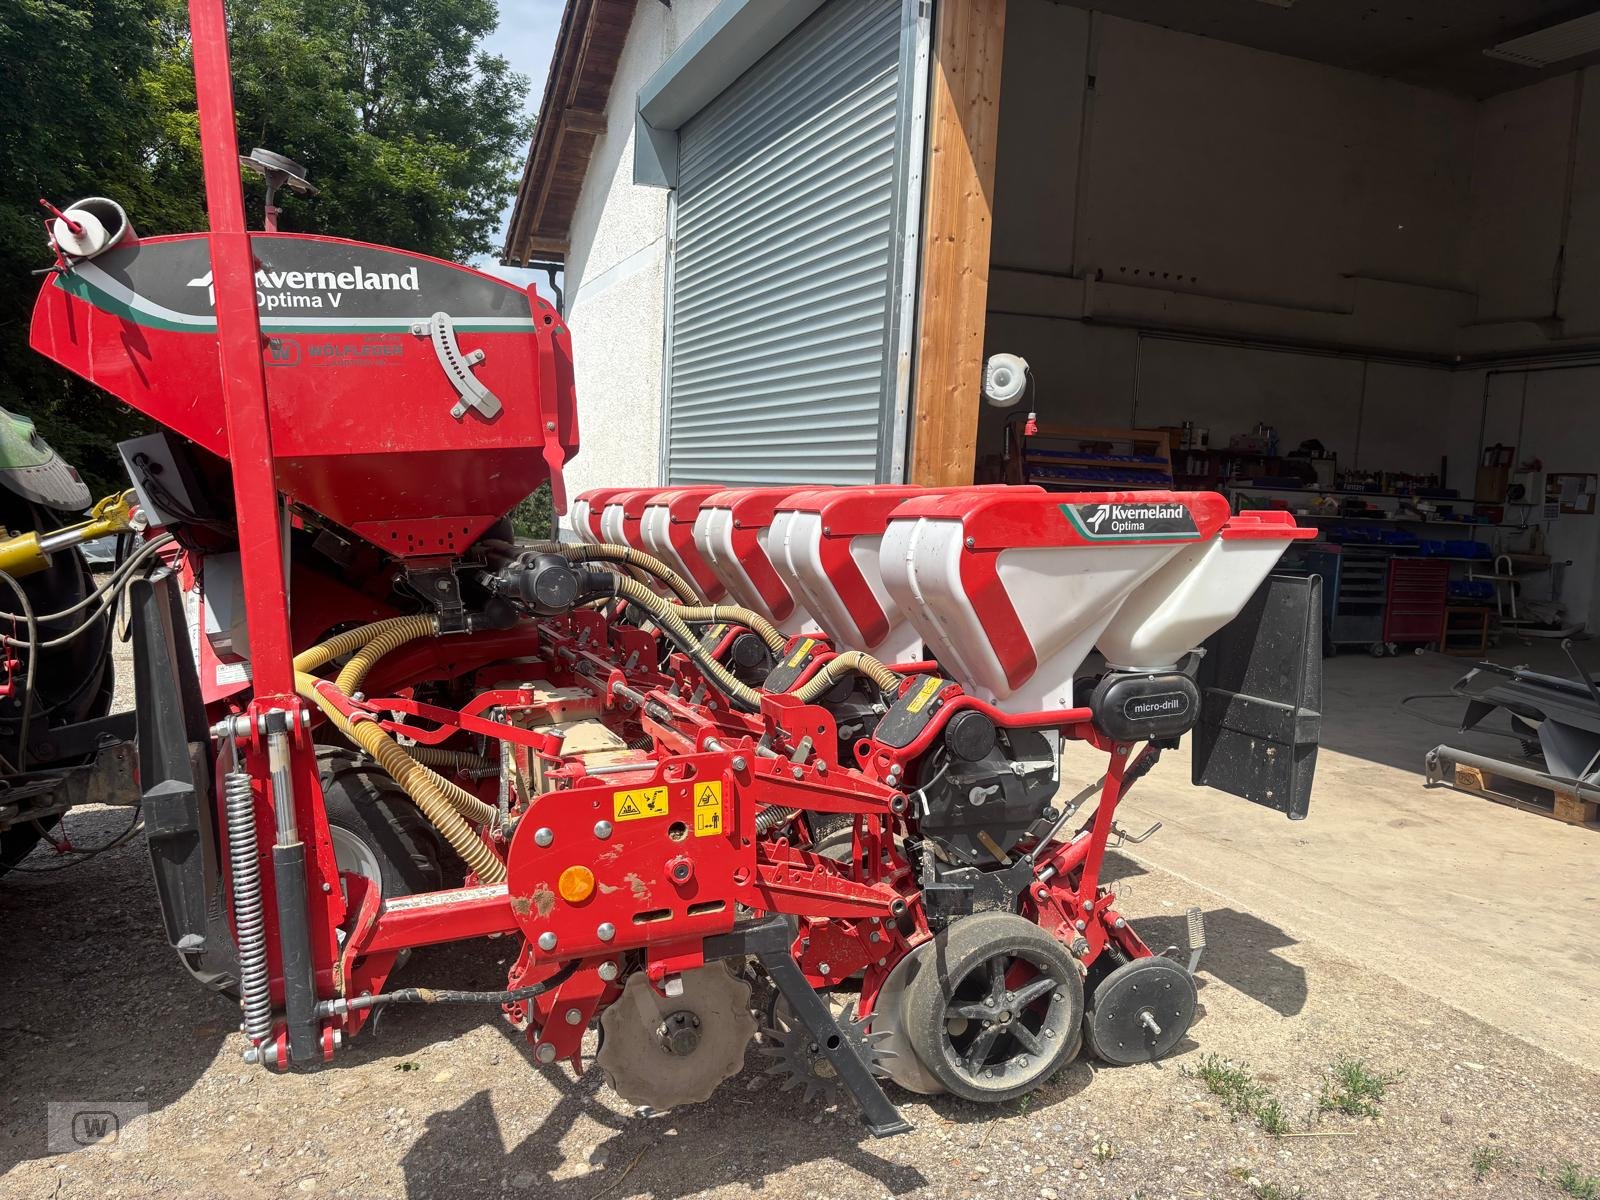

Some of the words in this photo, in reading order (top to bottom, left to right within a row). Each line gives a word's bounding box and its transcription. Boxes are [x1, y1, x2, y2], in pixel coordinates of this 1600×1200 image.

[327, 292, 342, 308] V
[1111, 504, 1183, 519] Kverneland
[1111, 521, 1145, 533] Optima
[1134, 699, 1180, 713] micro-drill
